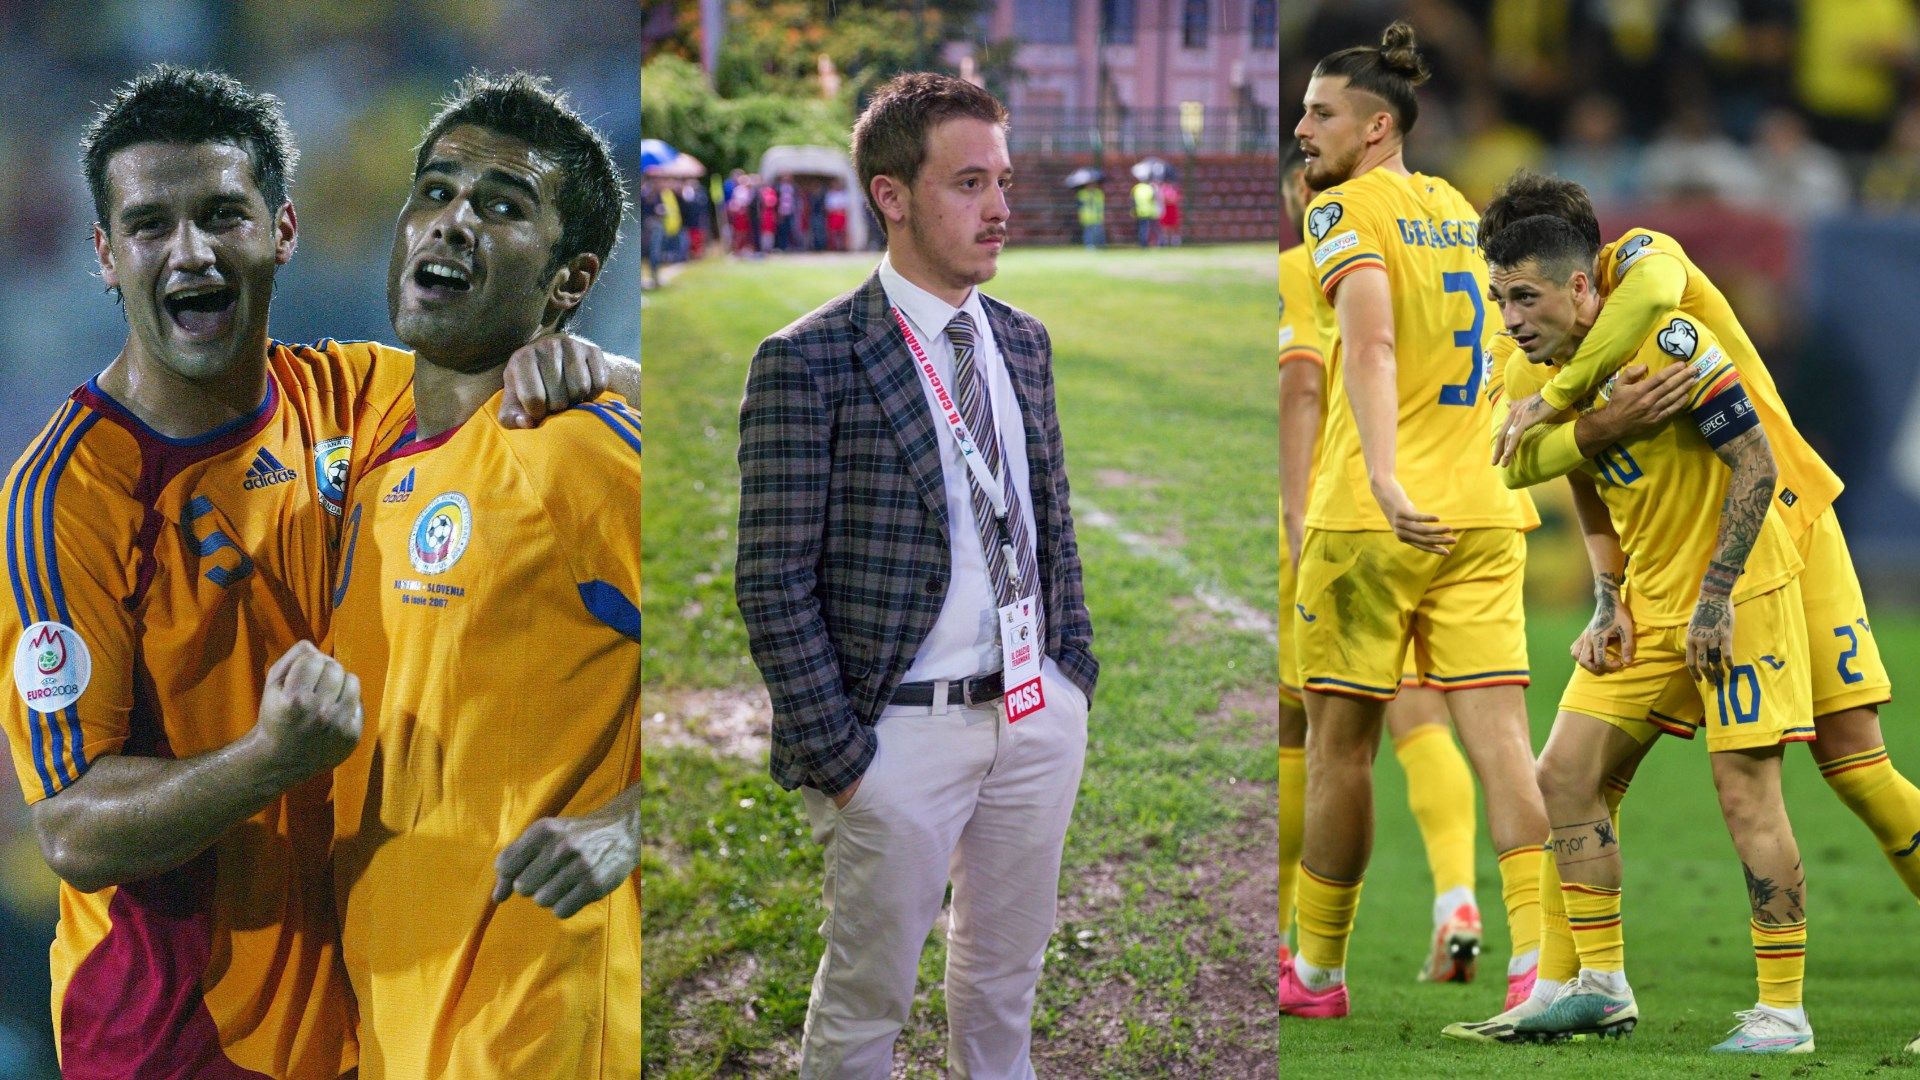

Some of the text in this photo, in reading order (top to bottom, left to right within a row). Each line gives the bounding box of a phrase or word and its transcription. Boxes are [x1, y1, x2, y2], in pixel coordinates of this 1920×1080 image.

[1438, 271, 1485, 407] 3
[924, 364, 954, 411] CALCIO
[1701, 413, 1727, 435] ESPECT
[243, 469, 297, 491] adidas
[1594, 443, 1644, 486] 10
[180, 494, 254, 589] 5
[427, 582, 465, 598] SLOVENIA
[1833, 625, 1864, 684] 2
[27, 684, 78, 700] EURO2008
[1007, 682, 1041, 718] PASS
[1715, 664, 1761, 726] 10
